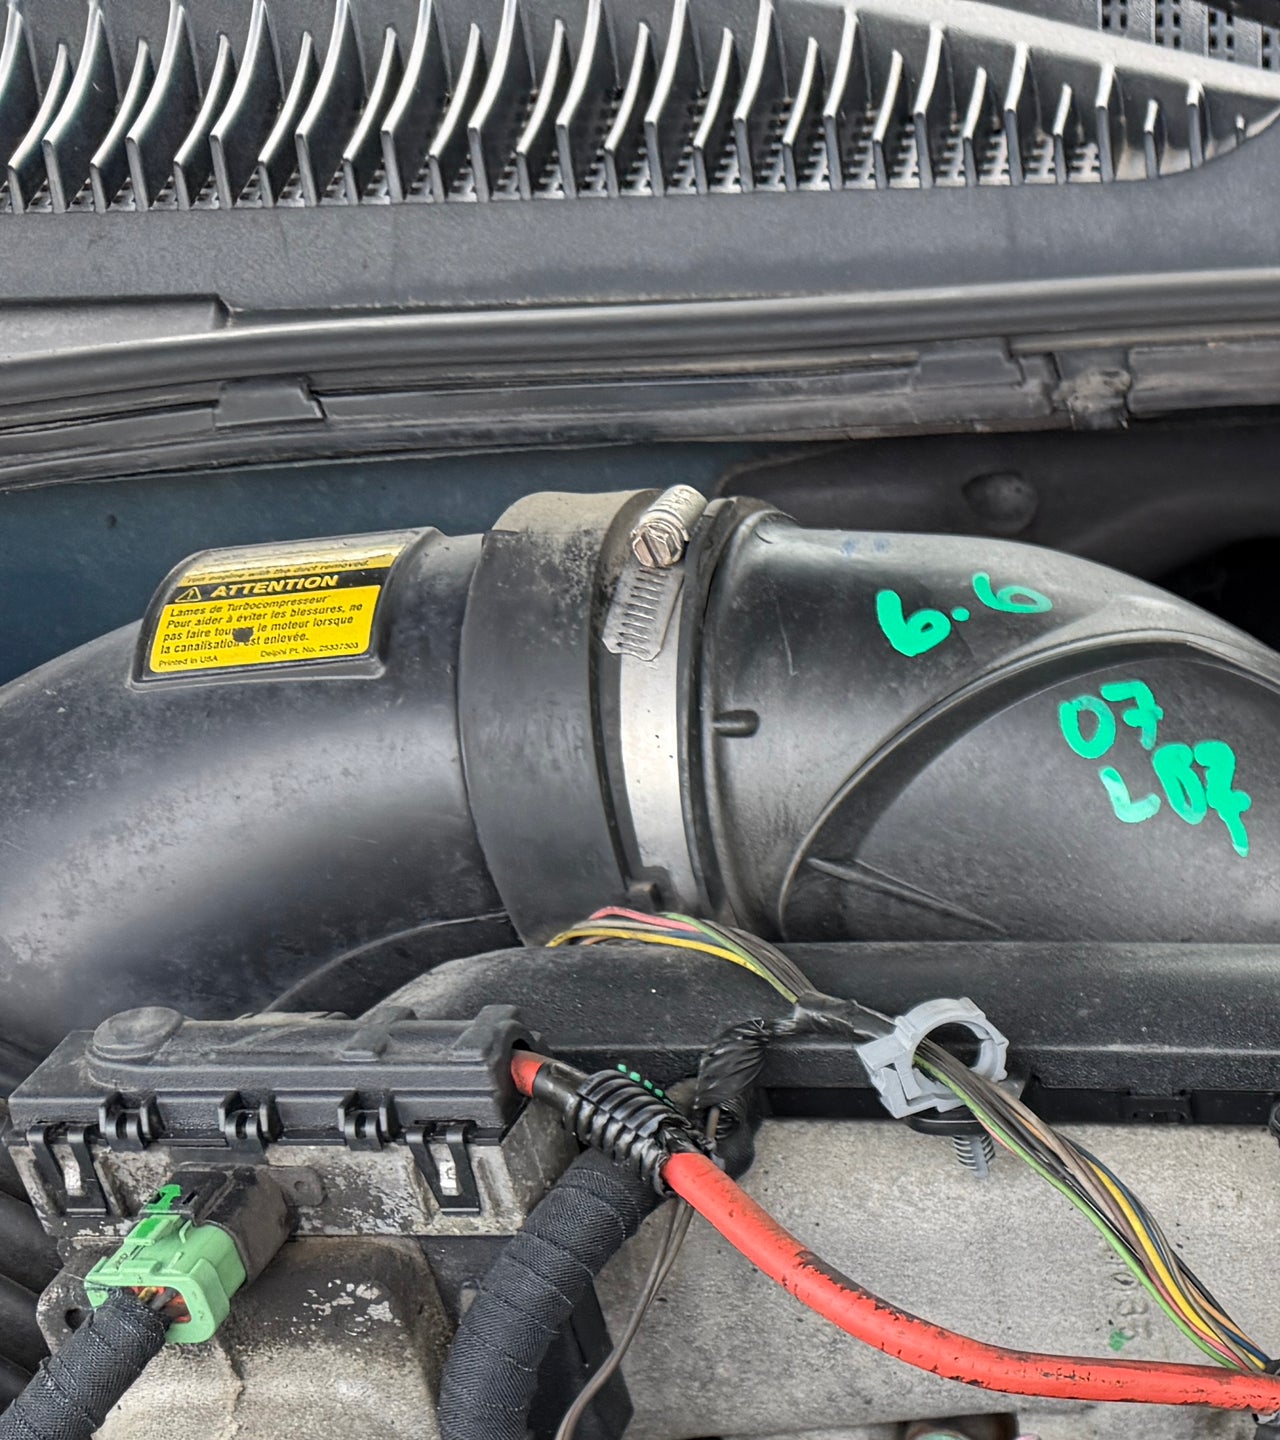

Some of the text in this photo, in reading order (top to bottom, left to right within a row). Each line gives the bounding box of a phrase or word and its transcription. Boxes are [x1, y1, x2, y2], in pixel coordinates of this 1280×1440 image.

[210, 574, 339, 598] ATTENTION
[166, 619, 191, 629] Pour
[194, 616, 224, 626] aider
[226, 614, 233, 623] à
[236, 611, 267, 622] éviter
[270, 610, 287, 619] les
[349, 603, 363, 612] ne
[170, 606, 206, 617] Lames
[210, 605, 223, 614] de
[876, 571, 1053, 657] 6.6
[163, 631, 183, 643] pas
[186, 628, 211, 639] faire
[257, 623, 267, 633] le
[271, 619, 310, 631] moteur
[312, 616, 354, 627] lorsque
[159, 655, 219, 667] Printed in USA
[160, 645, 171, 655] la
[260, 648, 287, 658] Delphi
[1059, 680, 1163, 759] 07
